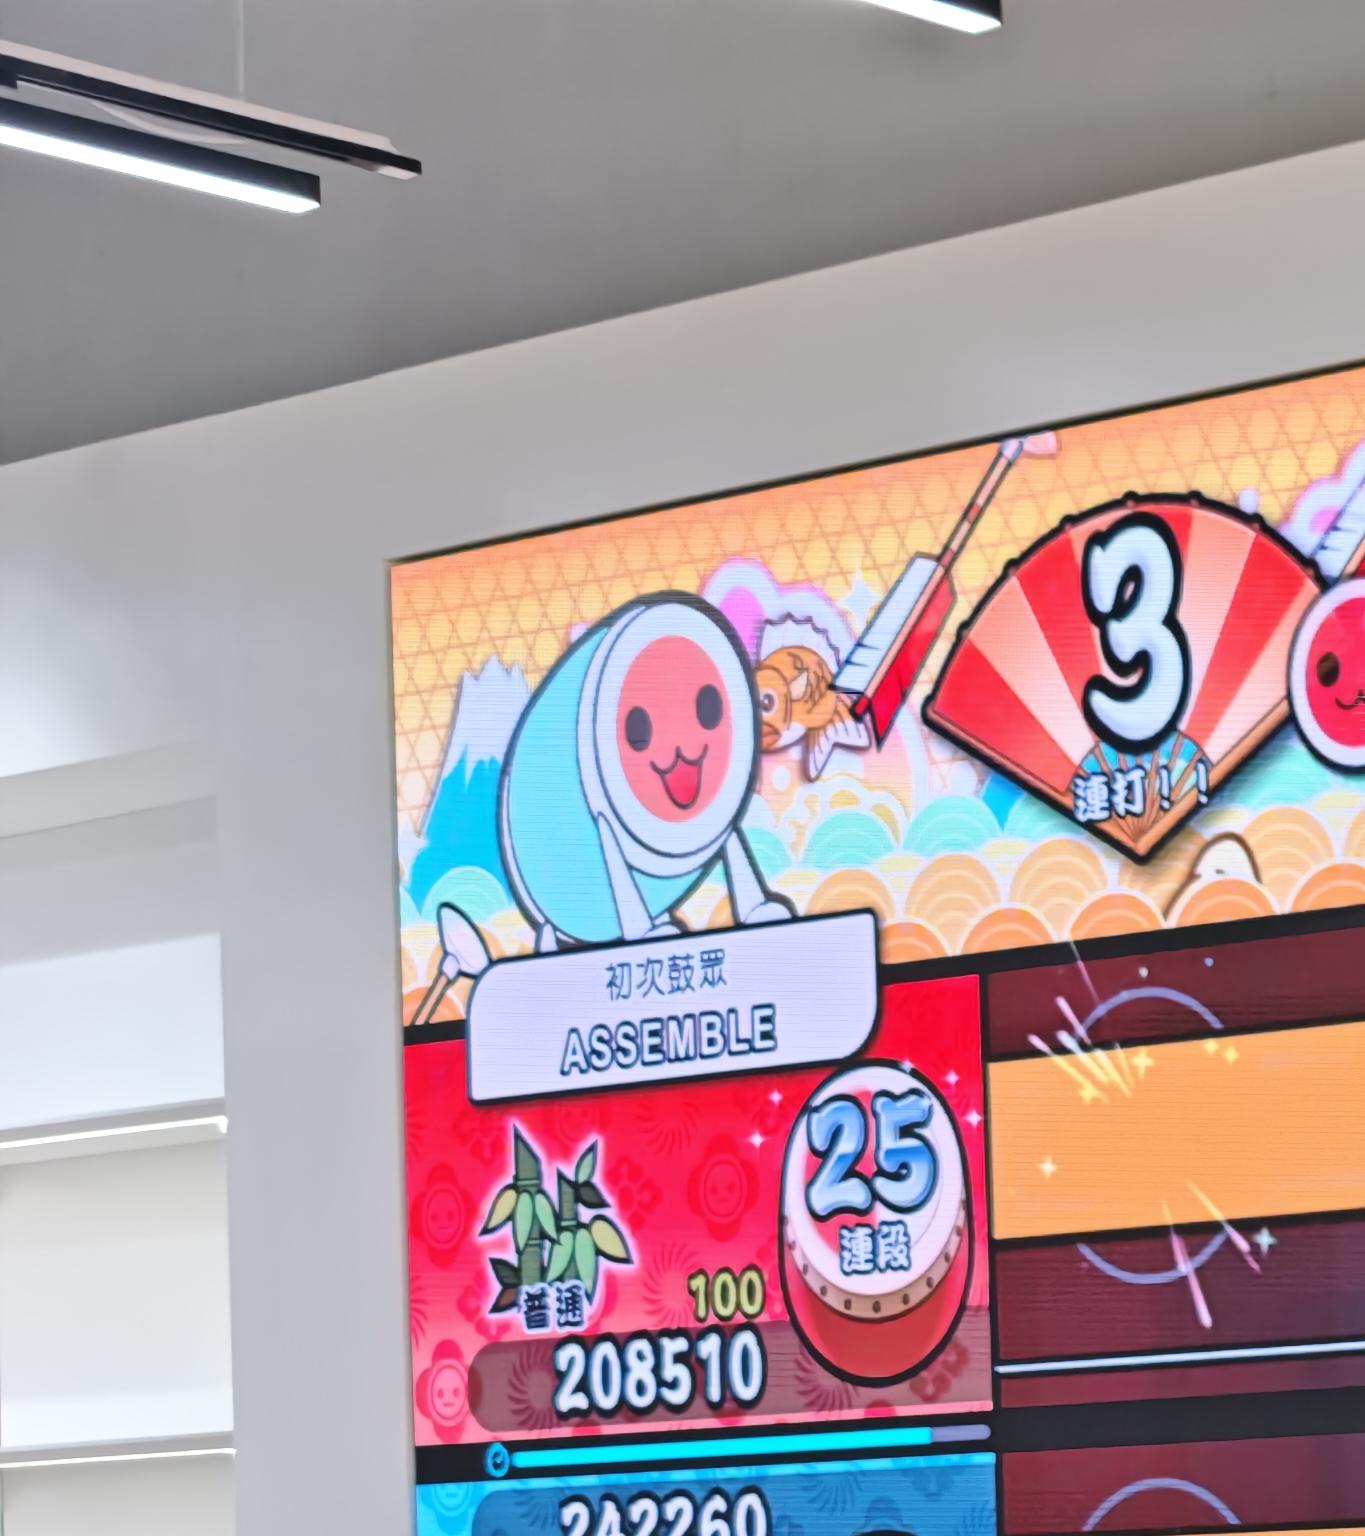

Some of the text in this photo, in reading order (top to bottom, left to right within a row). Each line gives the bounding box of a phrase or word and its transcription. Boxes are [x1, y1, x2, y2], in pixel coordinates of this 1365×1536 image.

[1084, 514, 1190, 752] 3
[560, 1003, 777, 1076] ASSEMBLE
[806, 1089, 938, 1217] 25
[840, 1221, 911, 1275] 連段
[689, 1270, 764, 1321] 100
[554, 1326, 767, 1416] 208510
